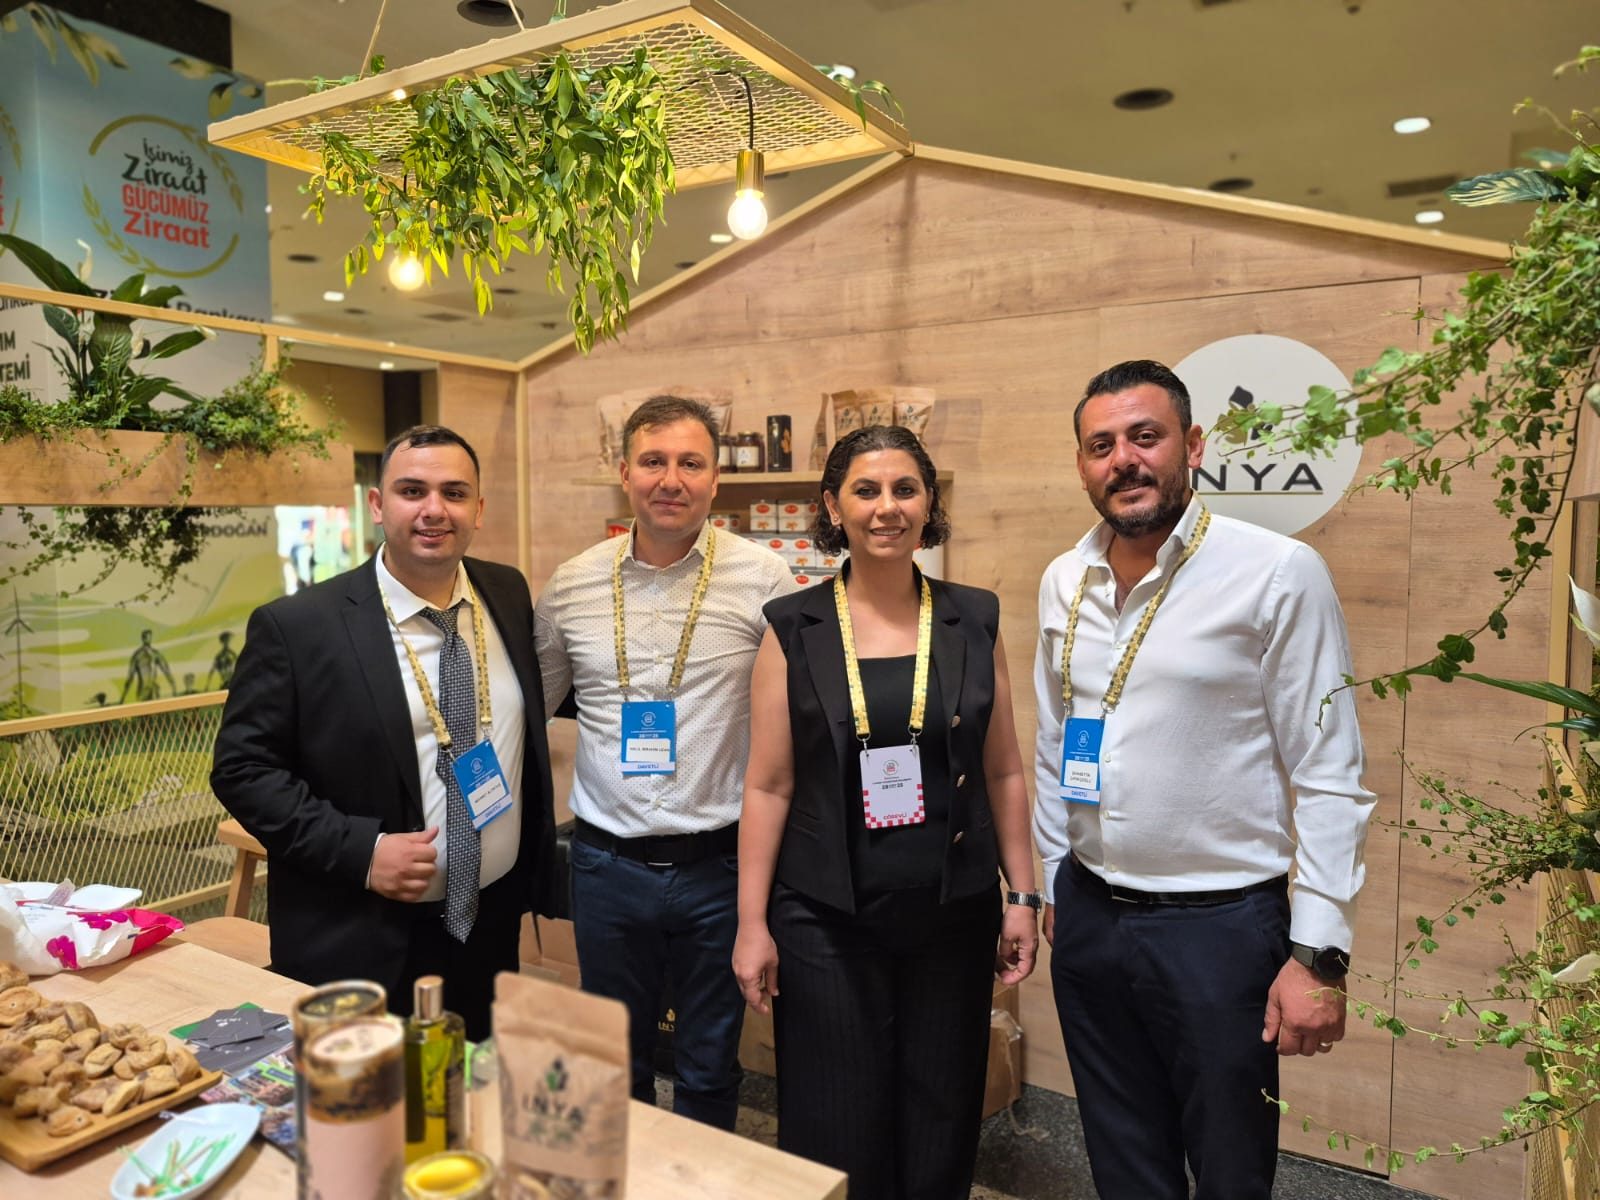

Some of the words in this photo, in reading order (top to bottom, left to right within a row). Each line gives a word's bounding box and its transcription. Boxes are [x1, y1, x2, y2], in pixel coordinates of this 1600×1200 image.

[121, 152, 207, 195] Ziraat
[122, 181, 209, 224] GÜCÜMÜZ
[123, 208, 209, 249] Ziraat
[1191, 463, 1324, 491] NYA
